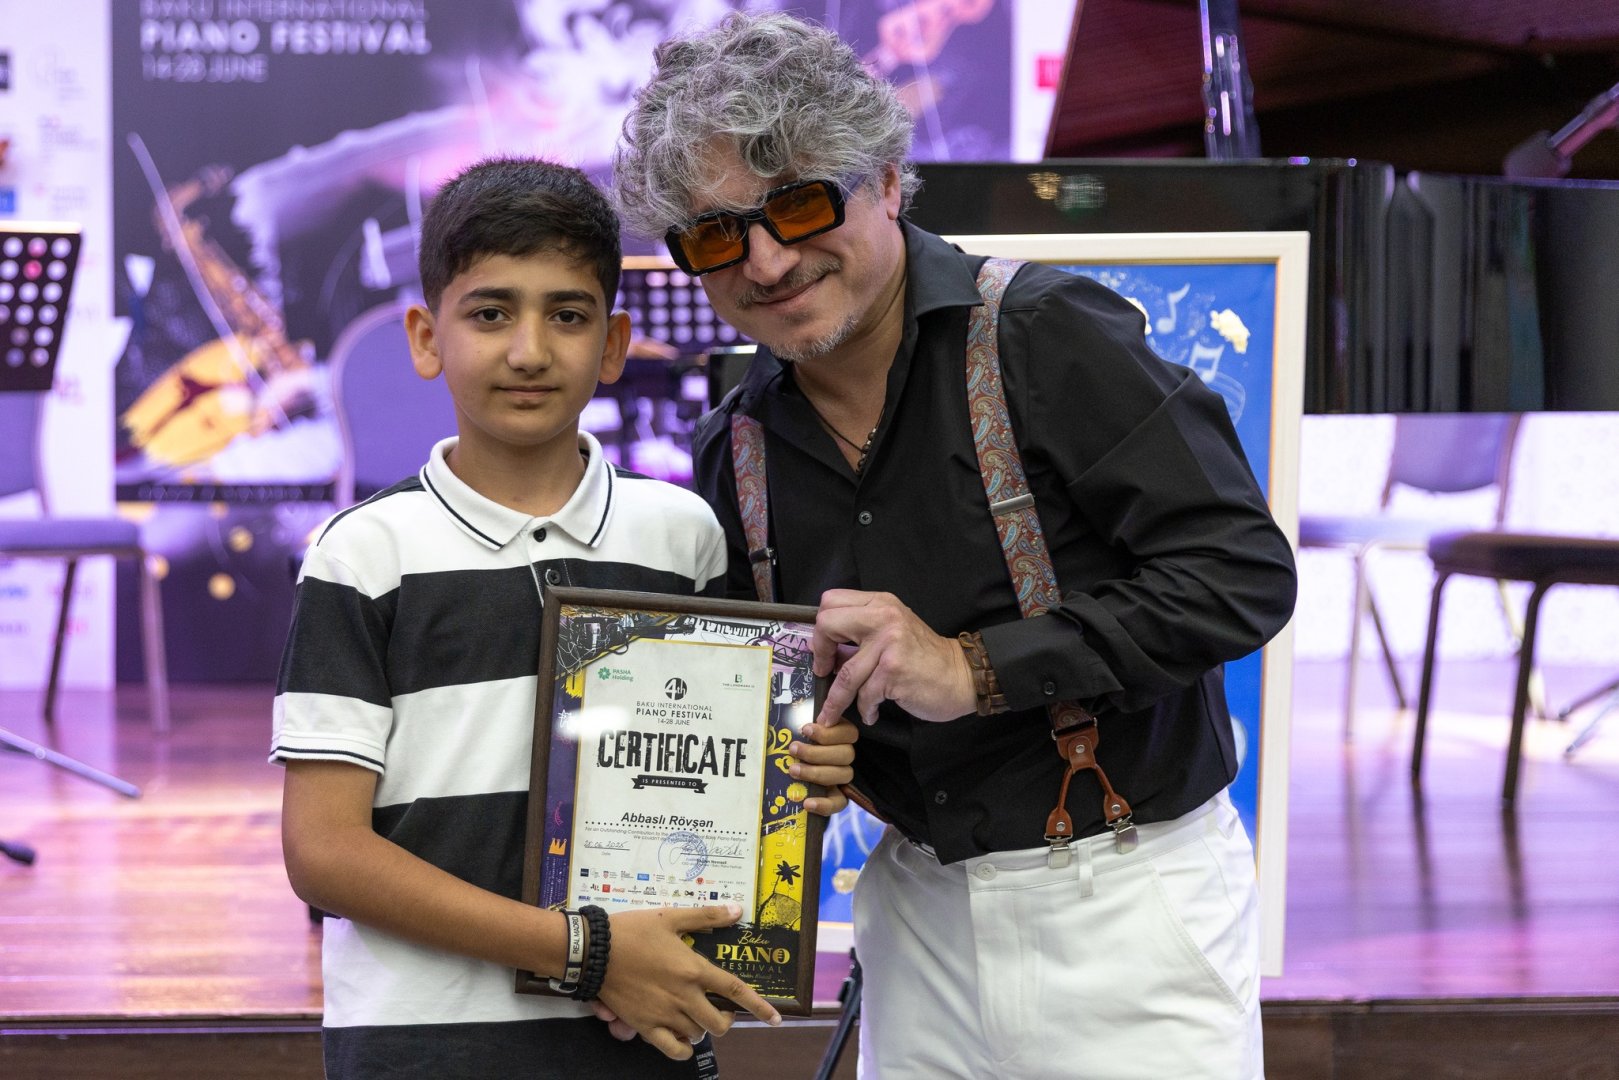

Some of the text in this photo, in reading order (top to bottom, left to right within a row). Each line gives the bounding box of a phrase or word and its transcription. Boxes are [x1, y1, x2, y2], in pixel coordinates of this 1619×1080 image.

[140, 19, 432, 54] PIANO FESTIVAL
[207, 53, 268, 82] JUNE
[665, 678, 687, 700] 4th
[636, 708, 713, 720] PIANO FESTIVAL
[657, 702, 713, 712] INTERNATIONAL
[597, 729, 748, 777] CERTIFICATE
[651, 779, 686, 787] PRESENTED
[620, 812, 714, 829] Abbaslı Rövşən
[737, 930, 770, 946] Baku
[716, 944, 791, 965] PIANO
[721, 962, 783, 974] FESTIVAL
